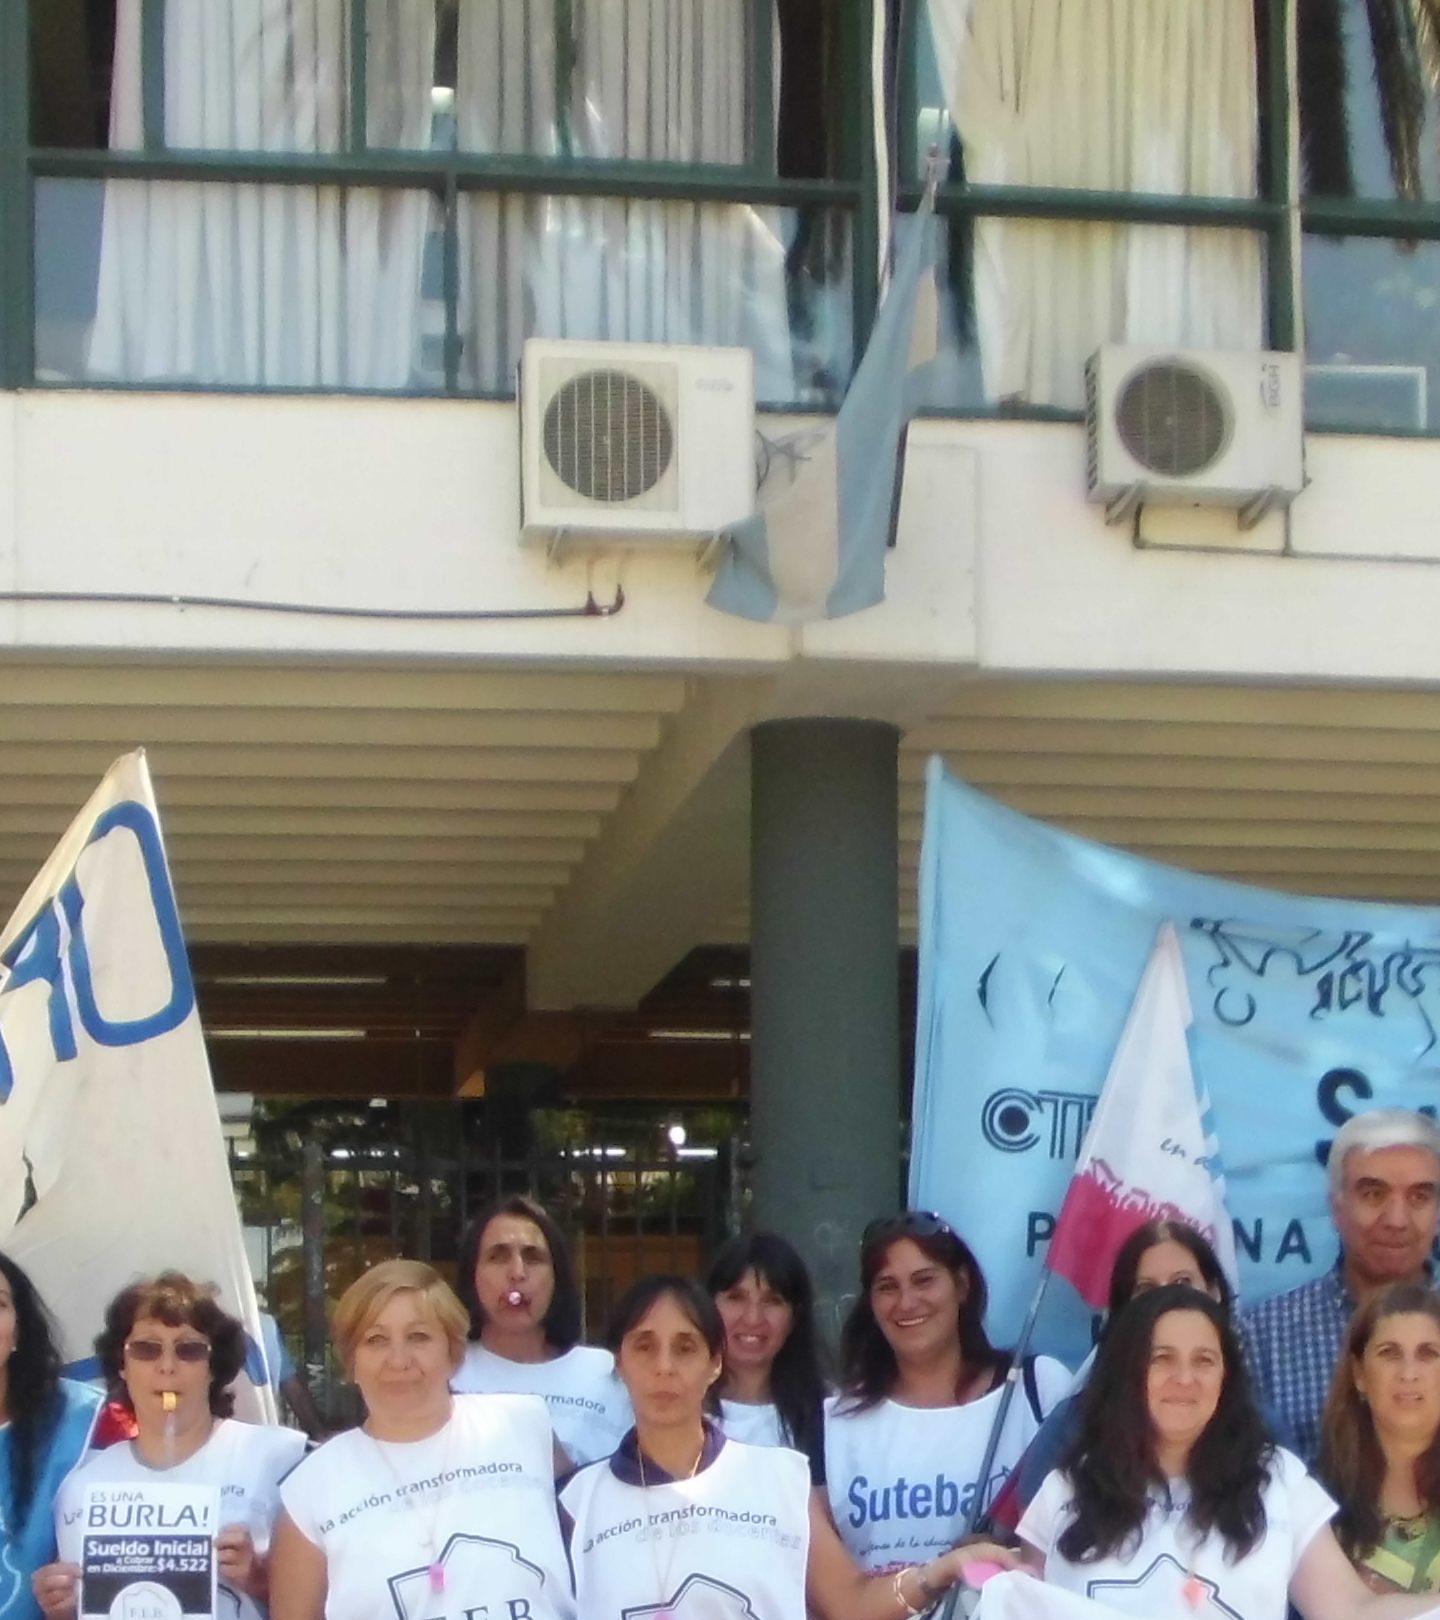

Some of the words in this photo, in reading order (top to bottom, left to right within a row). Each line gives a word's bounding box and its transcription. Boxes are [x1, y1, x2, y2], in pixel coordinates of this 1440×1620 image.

[395, 1462, 523, 1498] transformadora
[111, 1491, 145, 1503] UNA
[88, 1504, 209, 1529] BURLA!
[595, 1517, 642, 1545] acción
[648, 1503, 777, 1527] transformadora
[87, 1540, 150, 1557] Sueldo
[154, 1539, 209, 1557] Inicial
[157, 1557, 208, 1573] $4.522
